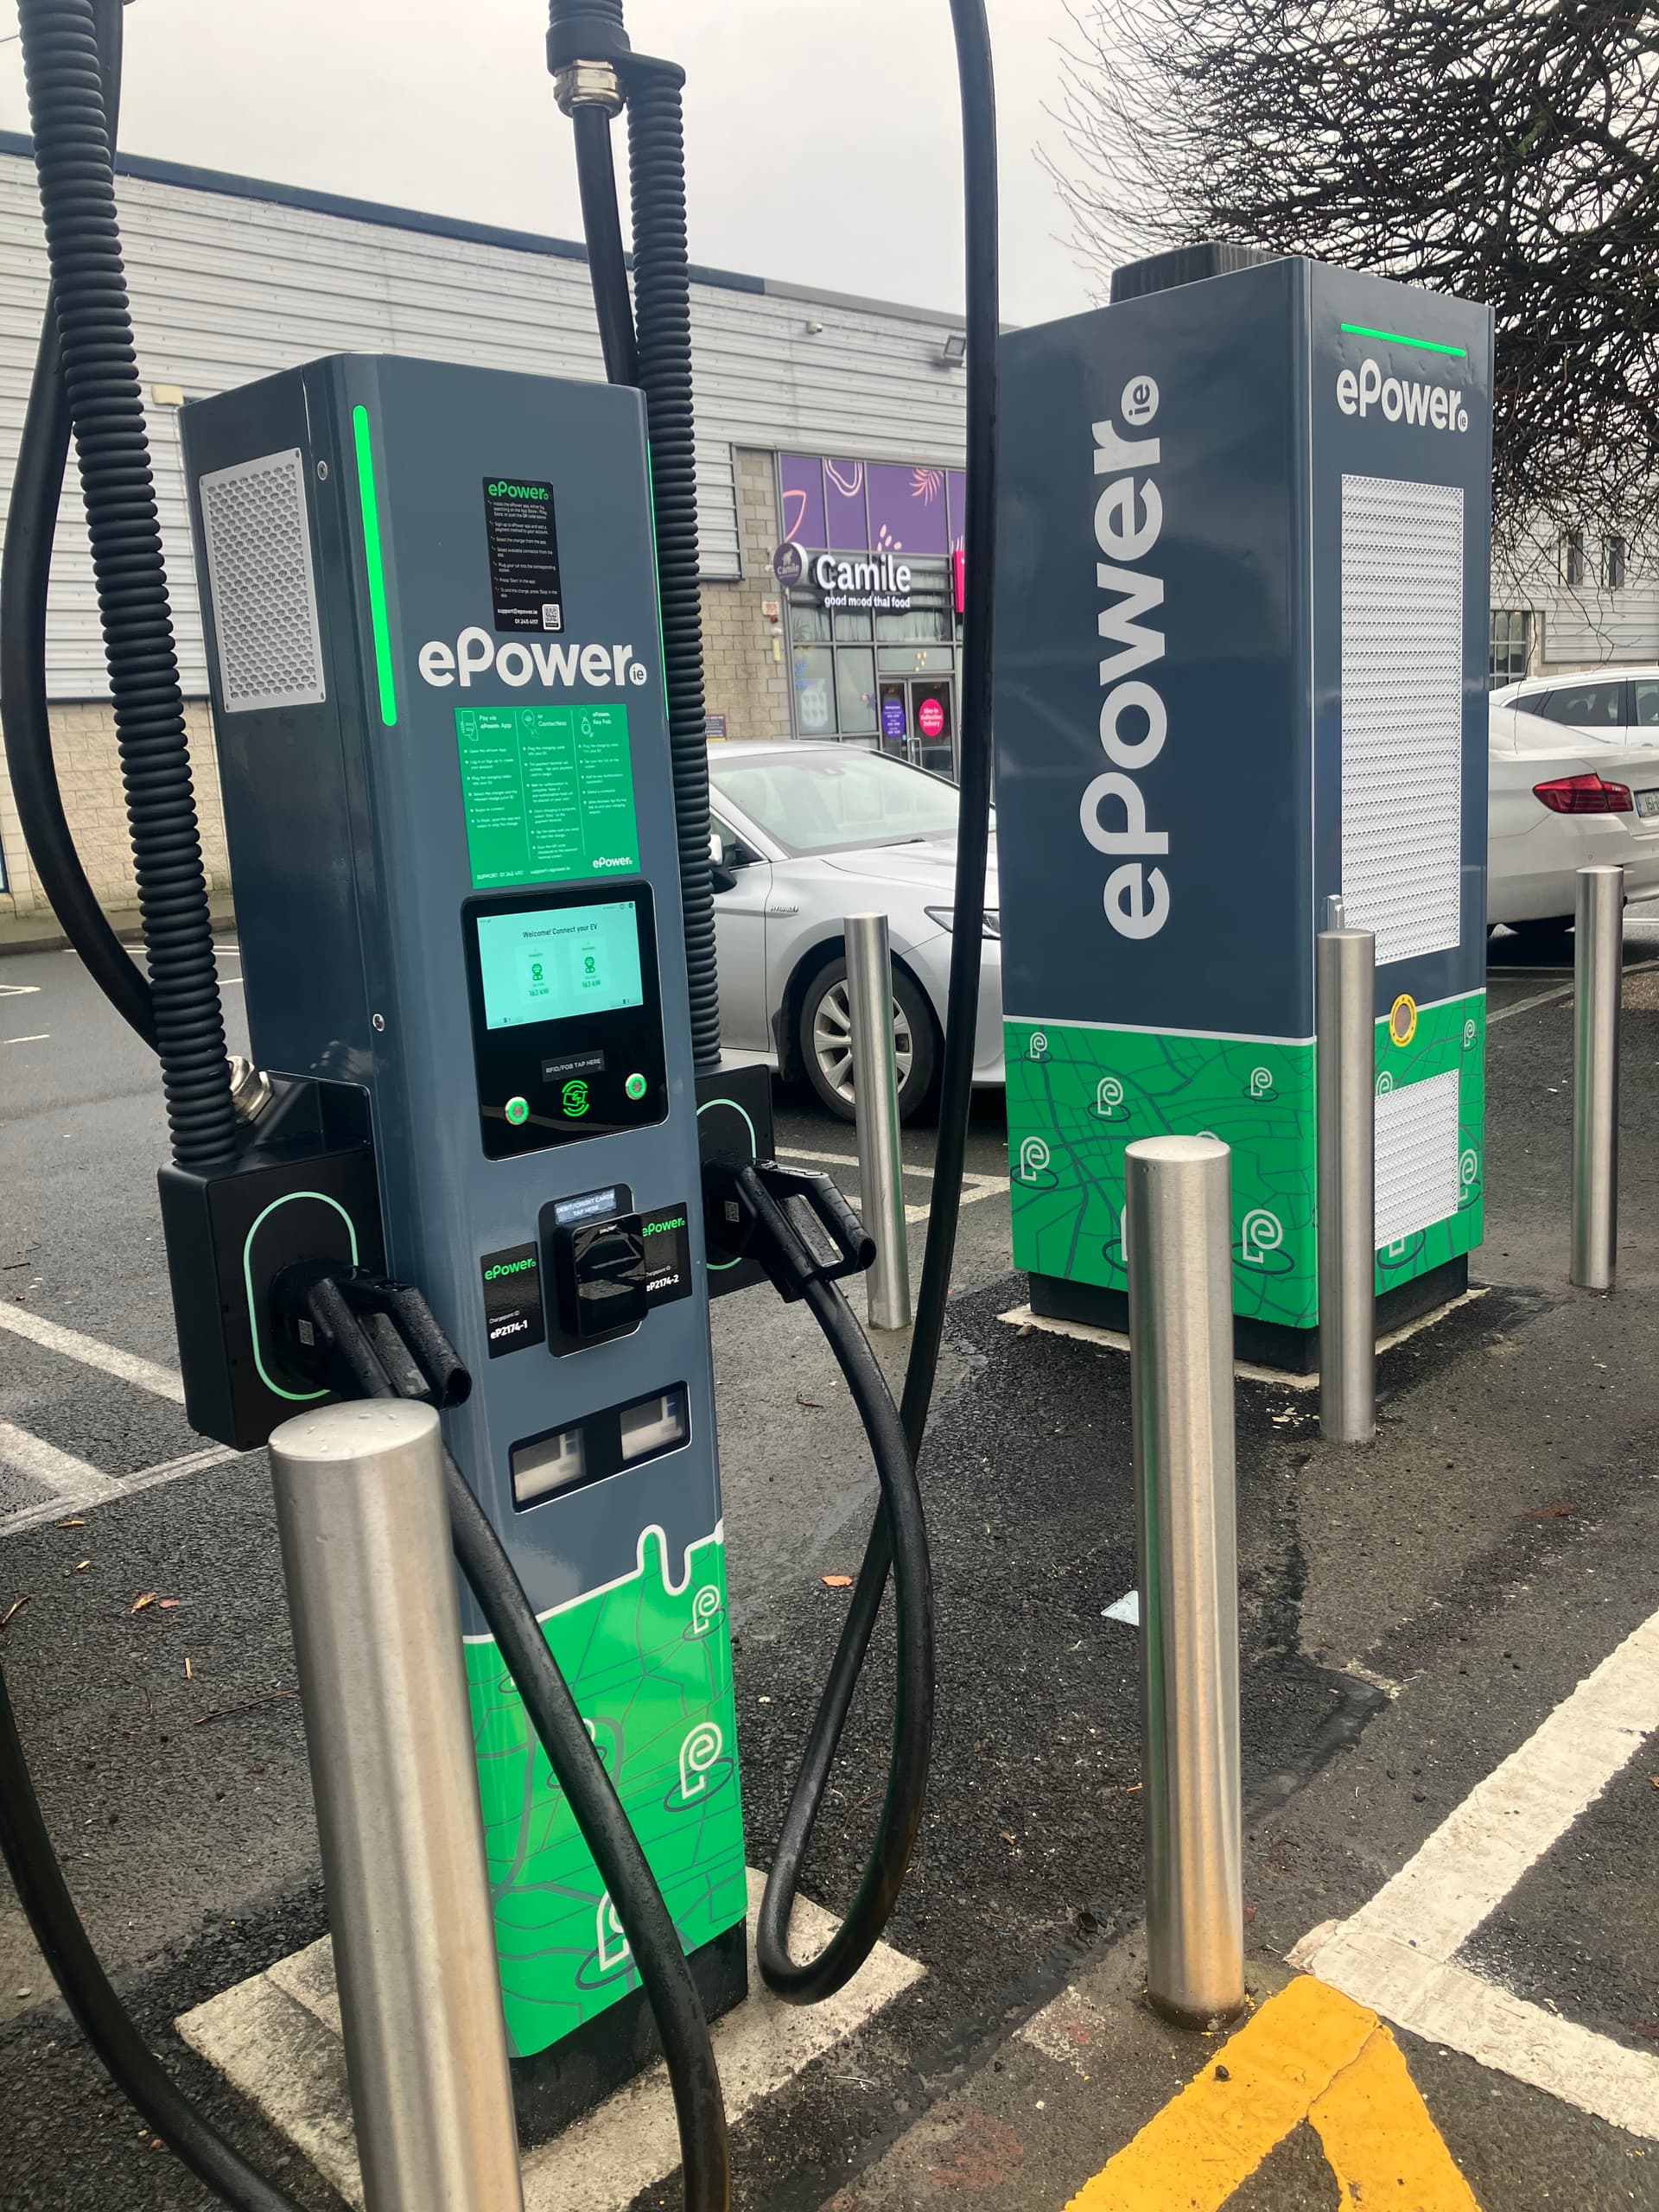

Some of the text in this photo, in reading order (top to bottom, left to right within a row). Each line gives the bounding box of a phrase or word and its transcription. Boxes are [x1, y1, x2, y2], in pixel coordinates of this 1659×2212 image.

[777, 563, 800, 575] Camile
[817, 554, 912, 593] Camile
[824, 594, 911, 609] good mood thai food
[523, 928, 551, 938] Welcome!
[552, 926, 576, 935] Connect
[577, 925, 589, 933] your
[545, 1063, 574, 1073] RFID/FOB
[490, 1319, 528, 1339] eP2174-1
